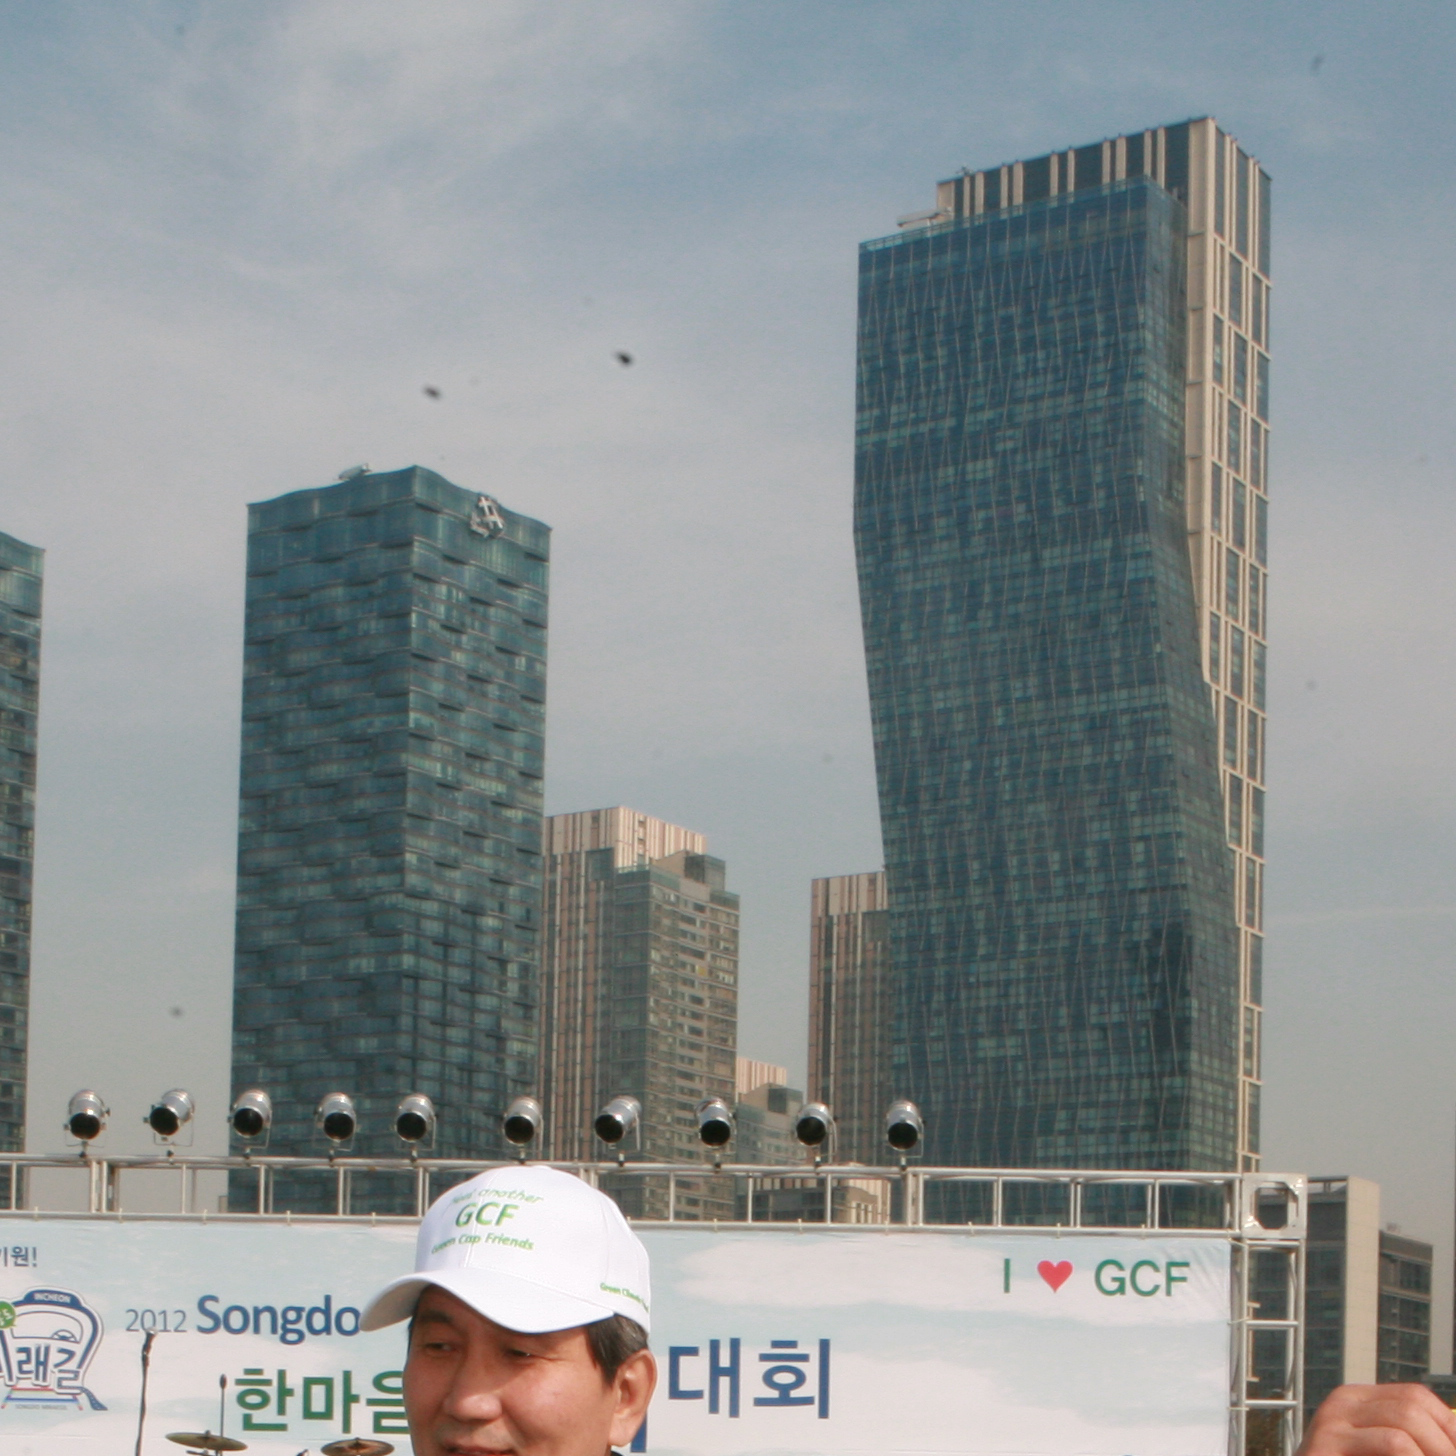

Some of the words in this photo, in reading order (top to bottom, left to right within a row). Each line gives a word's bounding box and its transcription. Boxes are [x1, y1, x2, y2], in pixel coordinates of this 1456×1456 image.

[455, 1201, 520, 1227] GCF
[459, 1233, 482, 1245] Cap
[485, 1232, 534, 1250] Friends
[1003, 1258, 1011, 1294] I
[1094, 1259, 1190, 1297] GCF
[125, 1309, 187, 1333] 2012
[196, 1294, 362, 1345] Songdo
[668, 1338, 831, 1419] 대회
